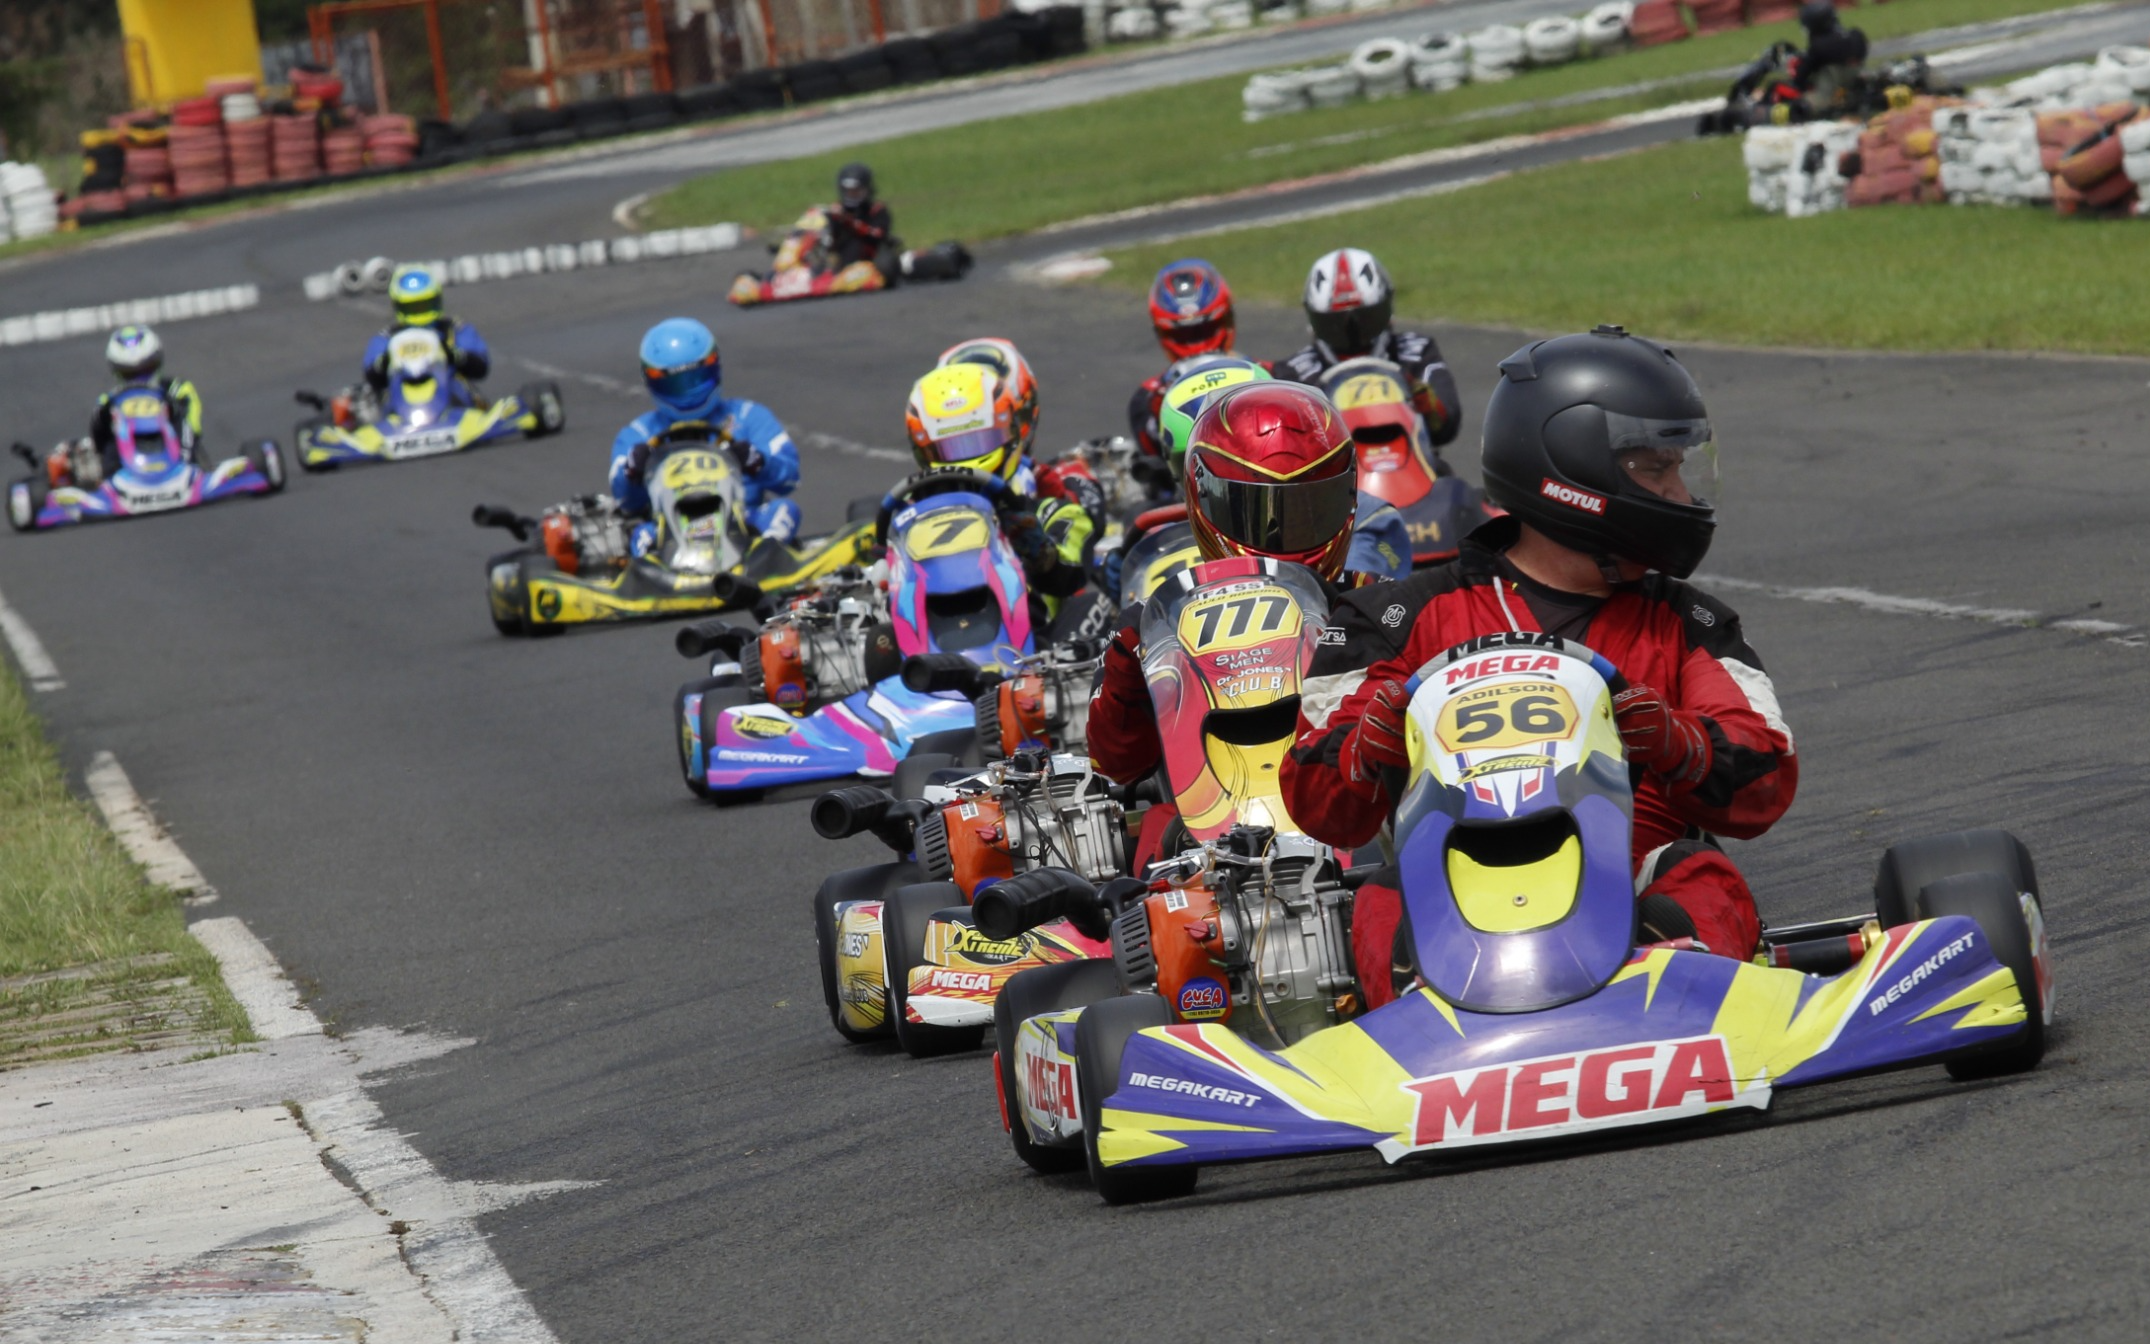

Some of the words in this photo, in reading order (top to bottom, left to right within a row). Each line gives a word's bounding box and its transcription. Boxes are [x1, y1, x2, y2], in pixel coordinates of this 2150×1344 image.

[667, 455, 718, 478] 20
[1543, 481, 1602, 513] MOTUL
[930, 517, 981, 549] 7
[1234, 582, 1260, 592] SS
[1194, 595, 1291, 650] 777
[1229, 656, 1264, 670] MEN
[1448, 631, 1565, 663] MEGA
[1442, 655, 1560, 686] MEGA
[1456, 684, 1555, 704] ADILSON
[1455, 695, 1567, 743] 56
[717, 749, 810, 764] MEGAKART
[931, 970, 992, 991] MEGA
[1868, 931, 1975, 1016] MEGAKART
[1026, 1052, 1077, 1120] MEGA
[1128, 1072, 1262, 1108] MEGAKART
[1412, 1038, 1736, 1146] MEGA
